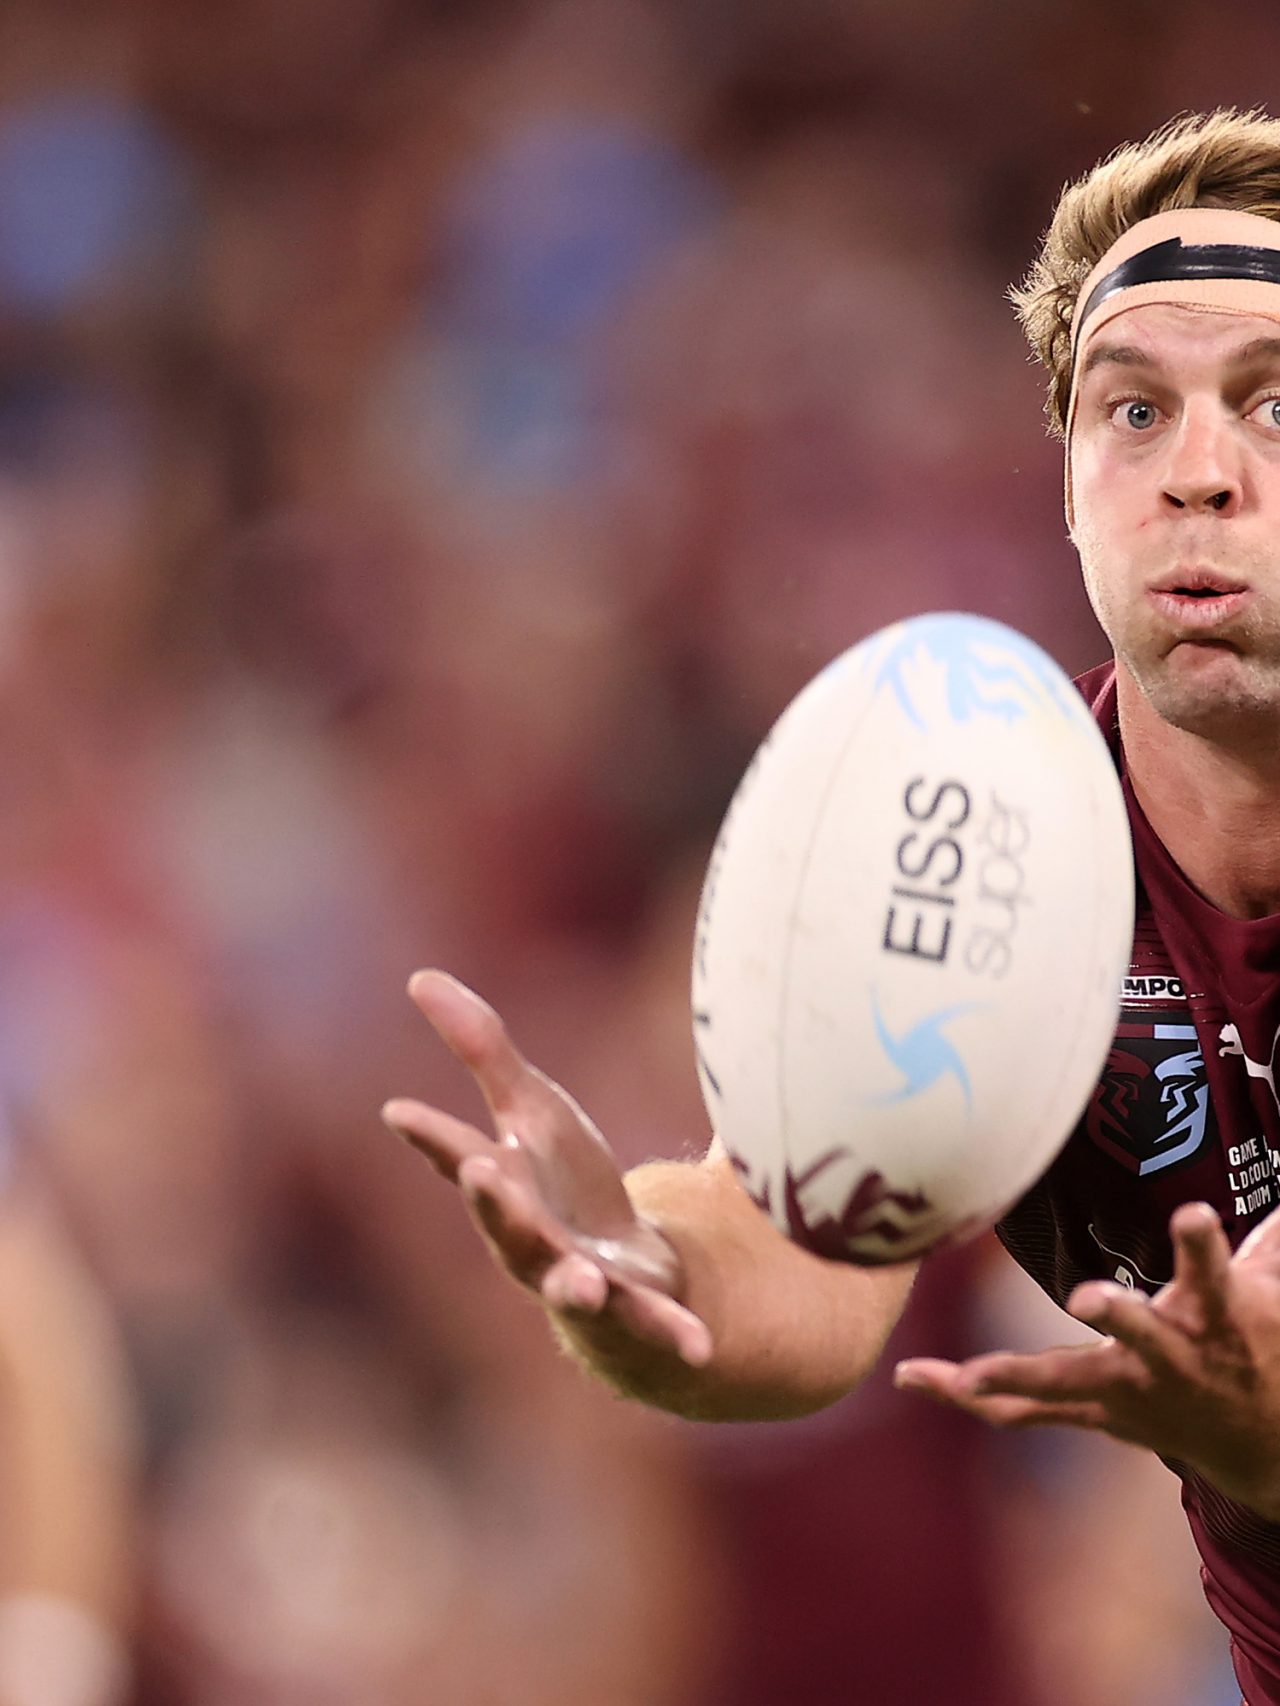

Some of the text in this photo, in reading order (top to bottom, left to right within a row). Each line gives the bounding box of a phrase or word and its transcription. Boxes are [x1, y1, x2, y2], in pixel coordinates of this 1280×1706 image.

[882, 774, 970, 966] EISS
[963, 784, 1035, 980] super
[1123, 978, 1185, 997] MPO
[1228, 1138, 1259, 1166] GAME
